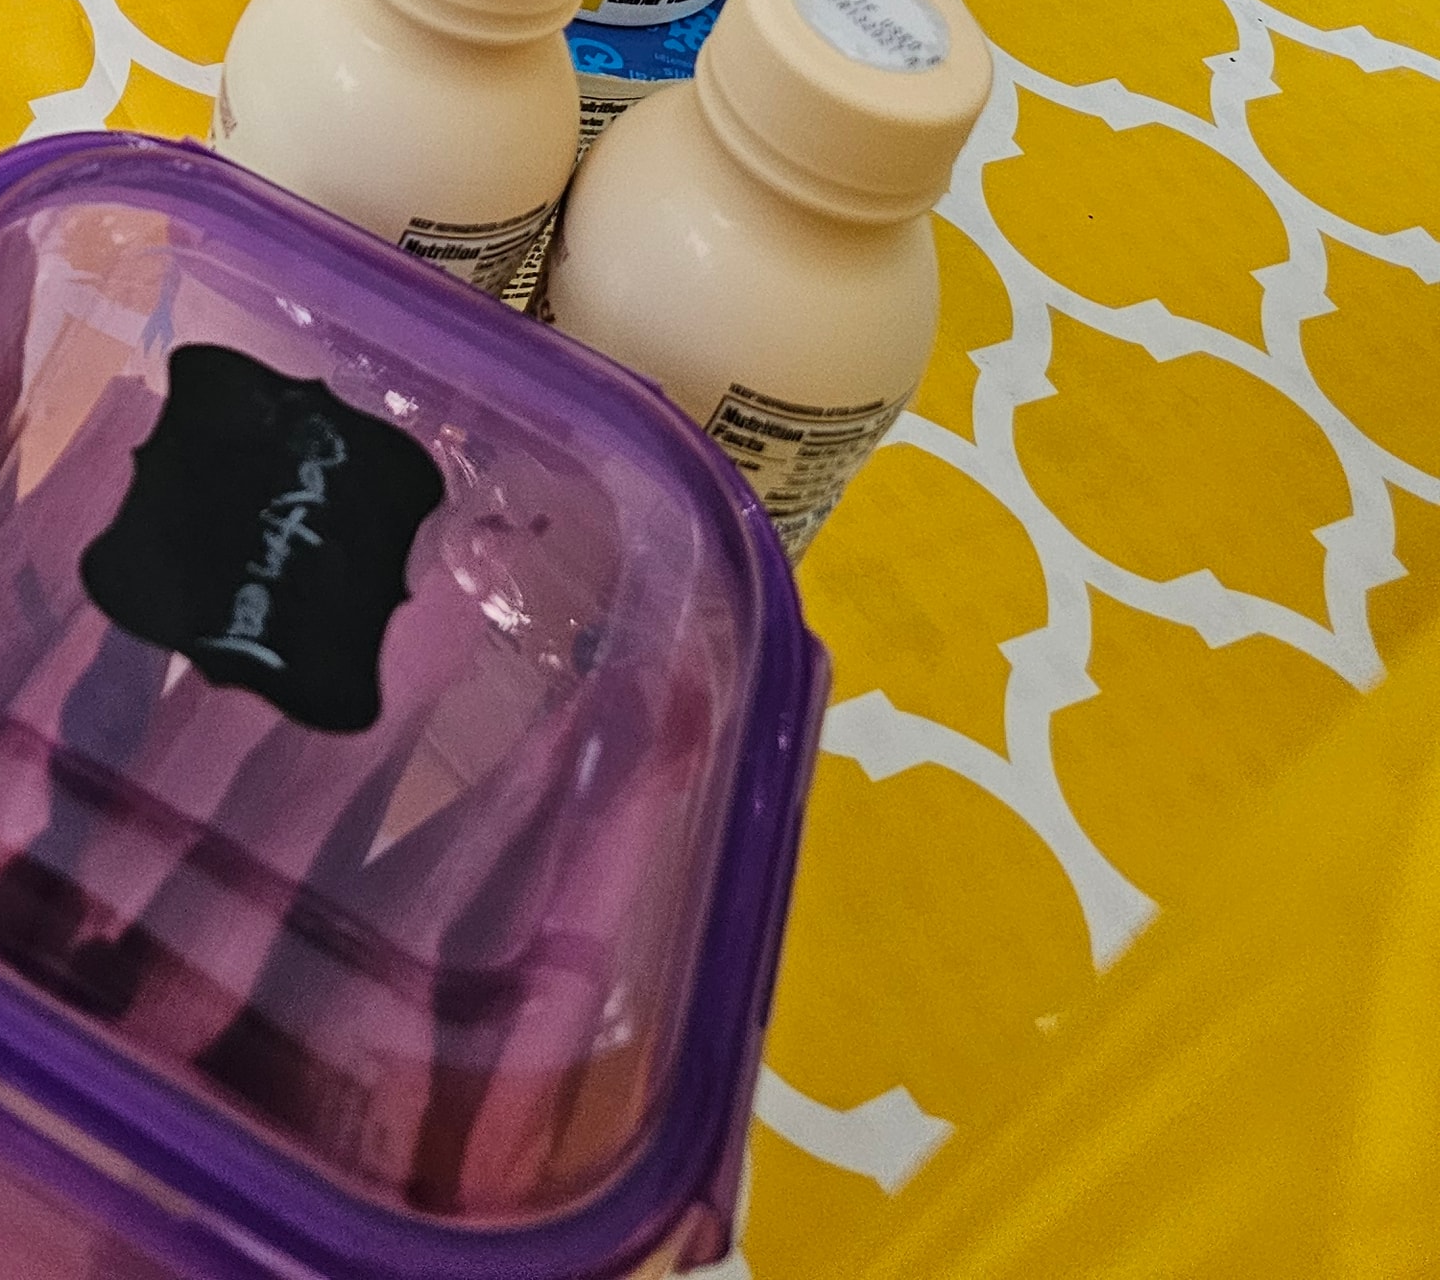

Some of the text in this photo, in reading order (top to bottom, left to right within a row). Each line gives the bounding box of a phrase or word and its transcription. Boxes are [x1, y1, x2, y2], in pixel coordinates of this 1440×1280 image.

[405, 237, 482, 261] Nutrition
[712, 423, 766, 453] Facts
[721, 405, 805, 442] Nutrition
